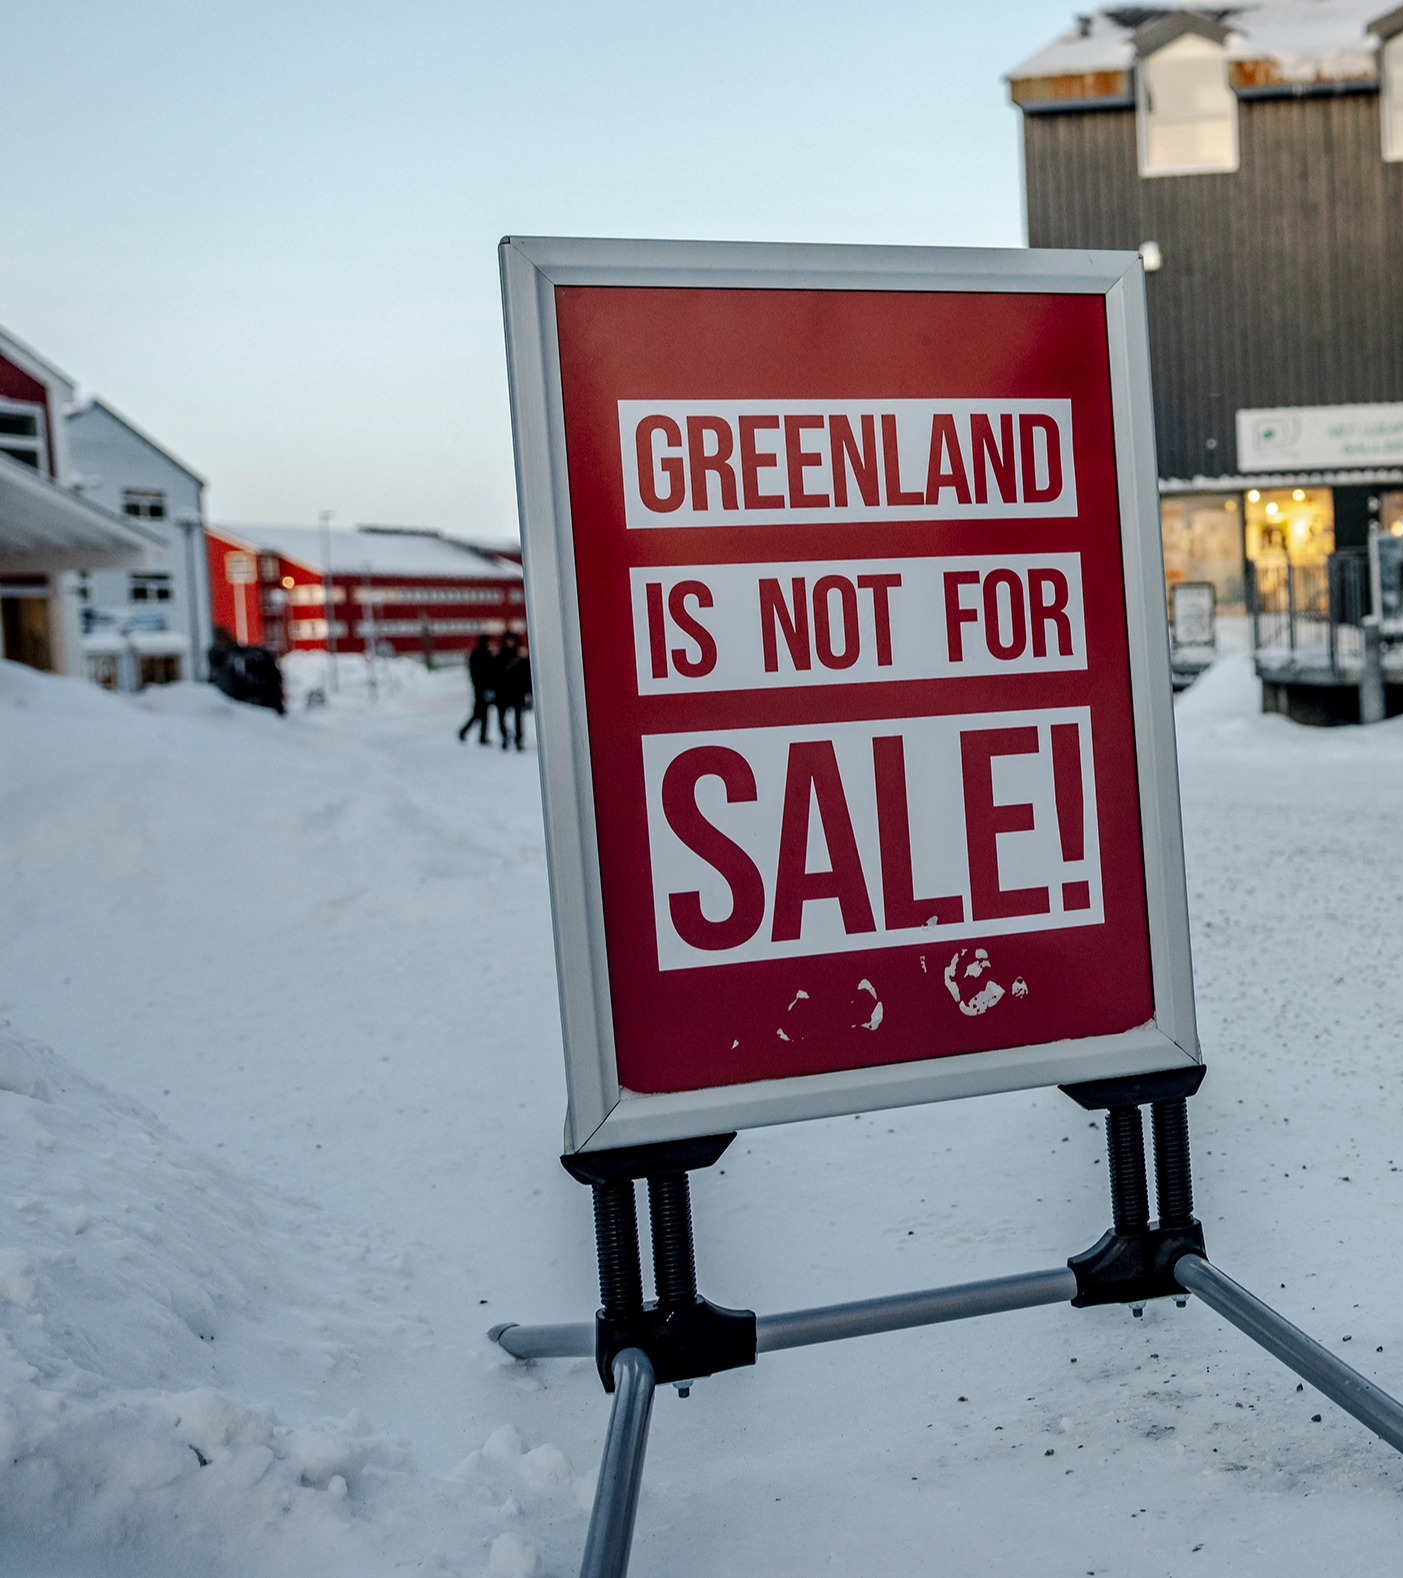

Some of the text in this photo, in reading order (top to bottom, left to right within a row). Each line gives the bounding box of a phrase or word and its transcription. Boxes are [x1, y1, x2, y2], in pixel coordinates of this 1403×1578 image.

[634, 412, 1063, 514] GREENLAND
[645, 567, 1074, 679] IS NOT FOR
[660, 722, 1091, 952] SALE!
